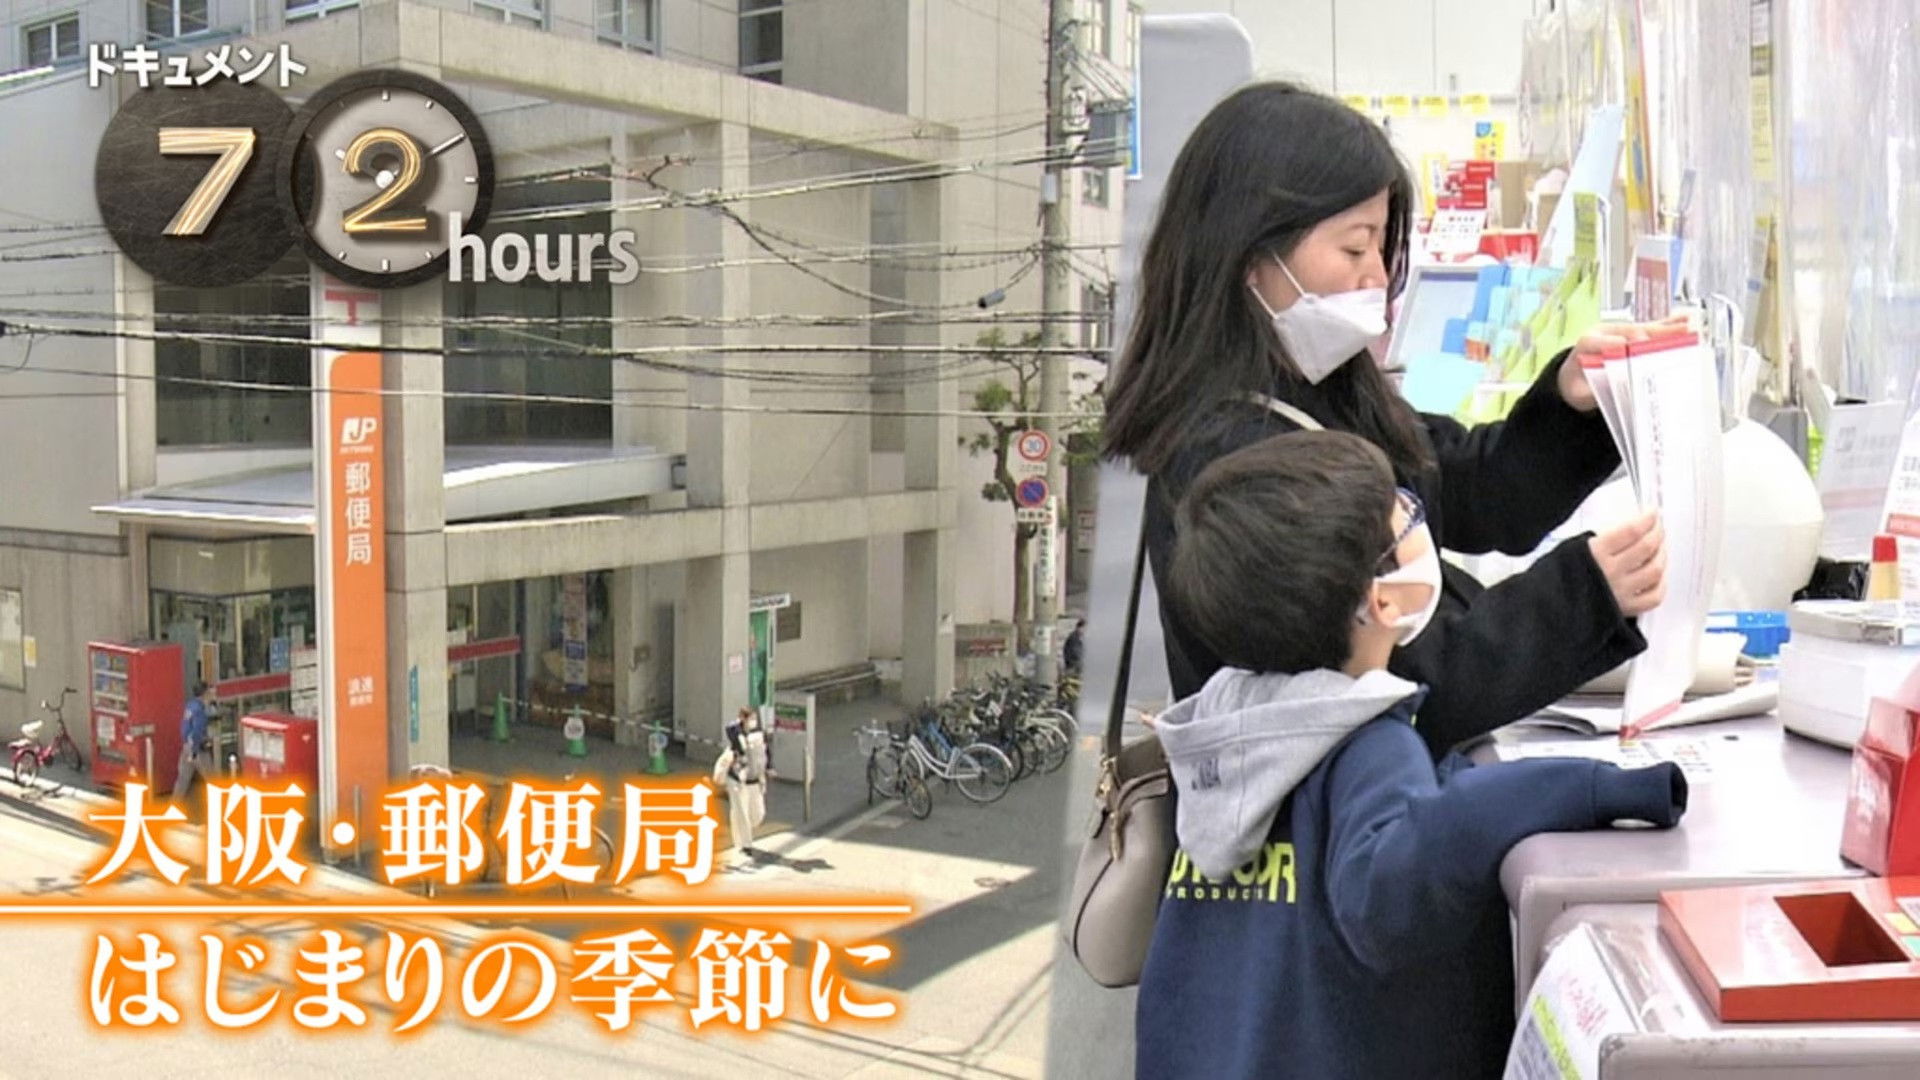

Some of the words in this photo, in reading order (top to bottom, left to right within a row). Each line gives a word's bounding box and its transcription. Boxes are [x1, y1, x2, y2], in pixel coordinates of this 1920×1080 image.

[341, 417, 377, 445] JP
[345, 462, 372, 568] 郵便局
